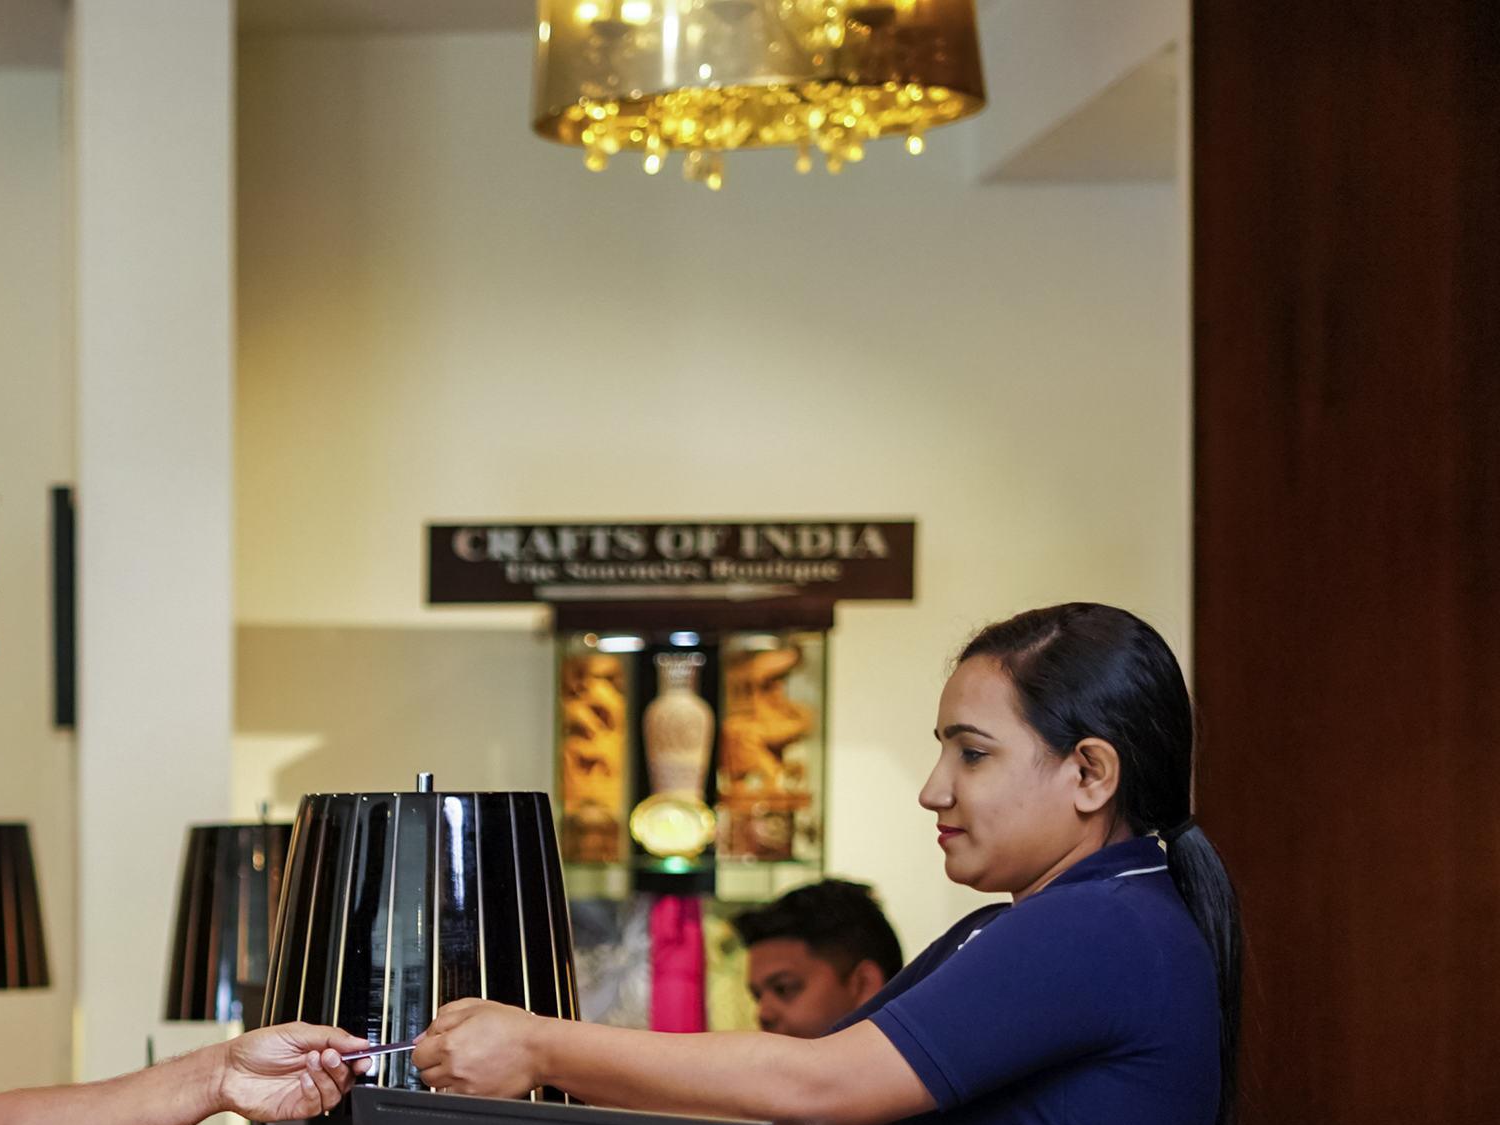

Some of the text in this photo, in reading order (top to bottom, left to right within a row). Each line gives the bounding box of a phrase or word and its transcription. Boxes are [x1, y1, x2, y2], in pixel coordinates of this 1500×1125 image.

[453, 524, 889, 561] CRAFTS OF INDIA
